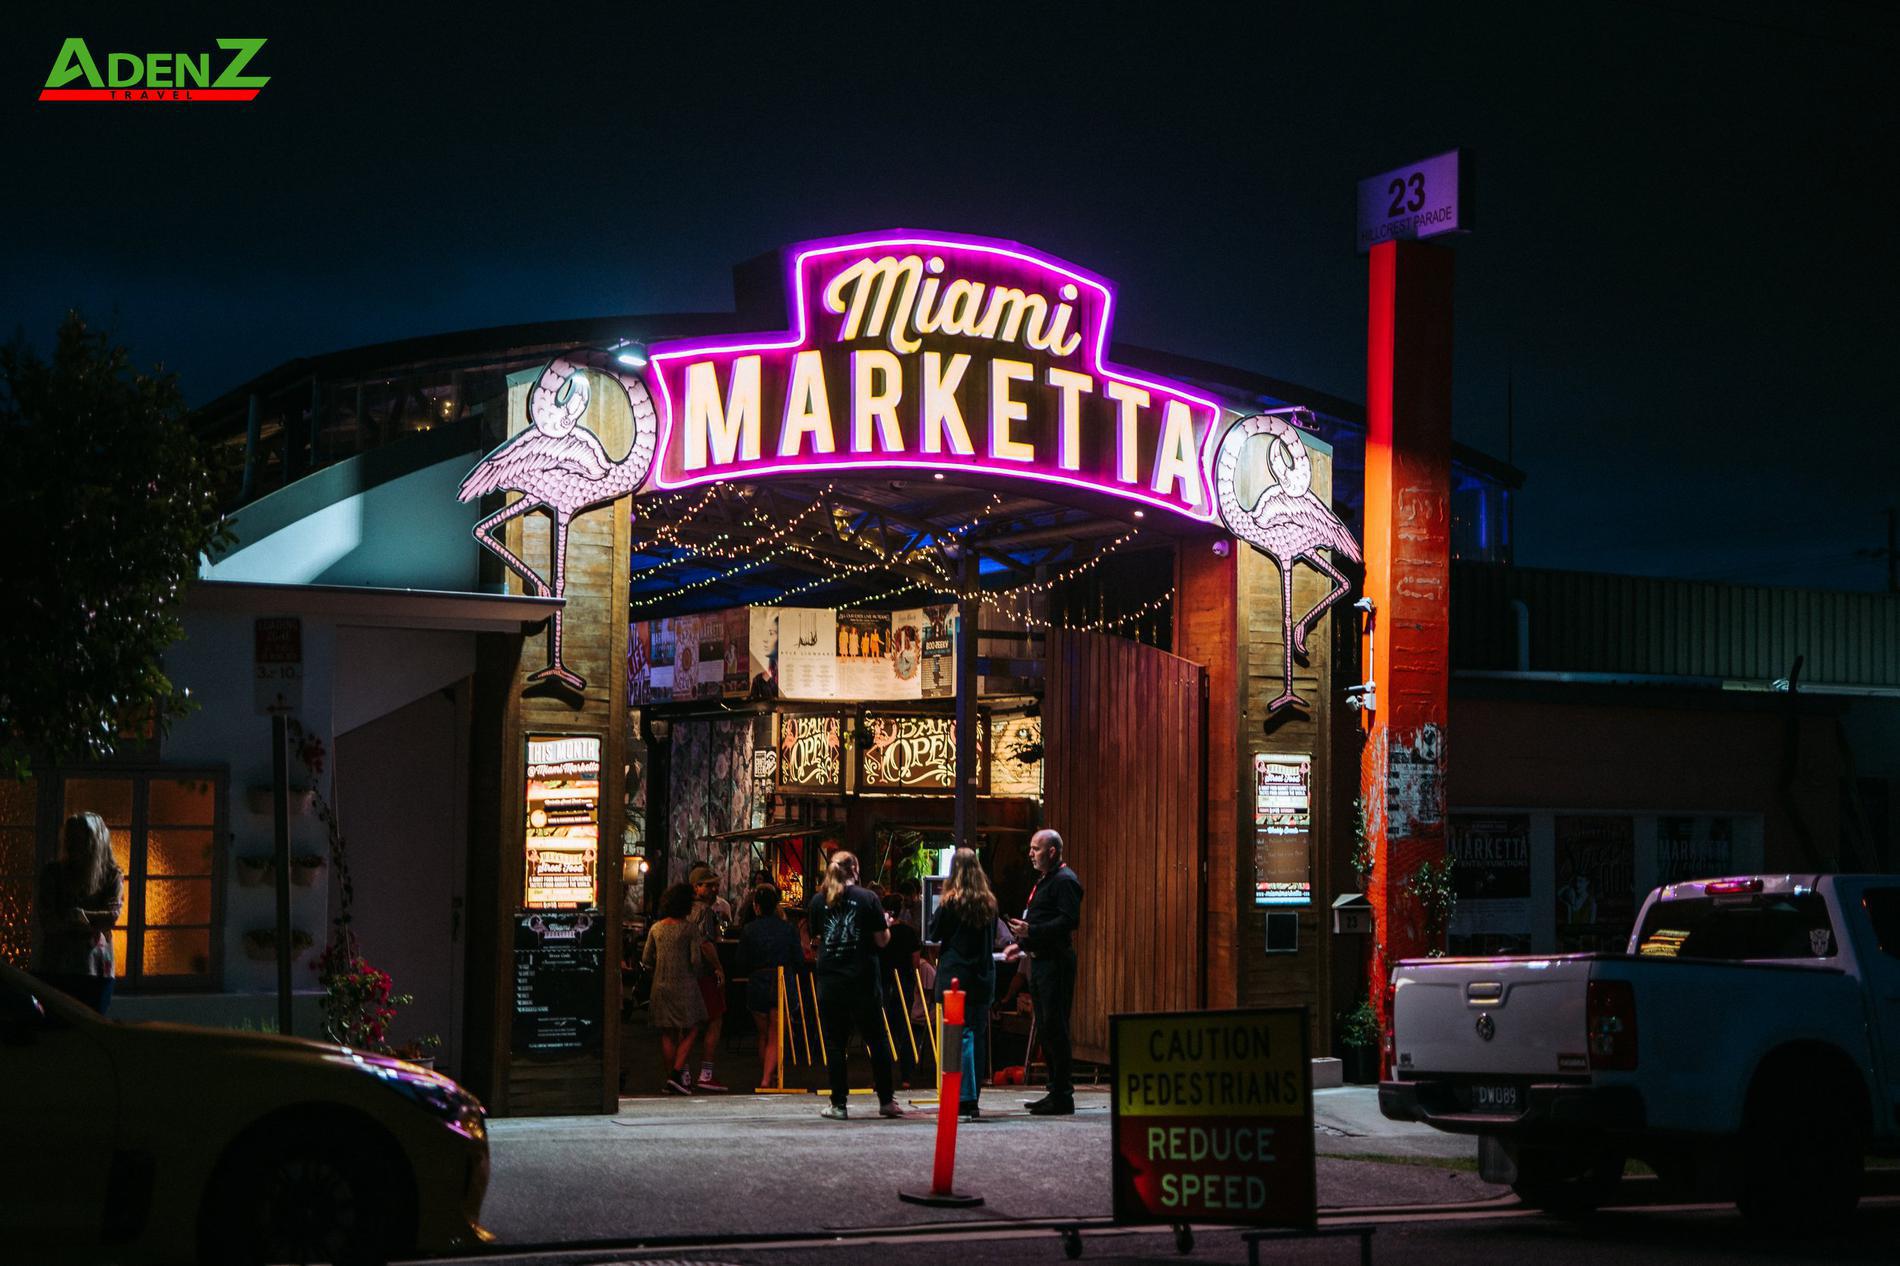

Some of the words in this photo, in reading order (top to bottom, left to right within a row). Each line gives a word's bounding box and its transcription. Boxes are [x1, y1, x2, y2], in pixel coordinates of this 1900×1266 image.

[1388, 171, 1426, 218] 23
[1361, 217, 1412, 241] HILLCREST
[1414, 206, 1453, 228] PARADE
[824, 254, 1083, 356] Miami
[683, 348, 1202, 503] MARKETTA
[798, 718, 825, 737] BAR
[896, 717, 950, 738] BAR
[529, 743, 553, 762] THIS
[556, 740, 595, 761] MONTH
[790, 732, 830, 782] OPEN
[882, 734, 957, 783] OPEN
[1150, 1024, 1271, 1062] CAUTION
[1127, 1070, 1298, 1106] PEDESTRIANS
[1148, 1126, 1277, 1162] REDUCE
[1161, 1173, 1267, 1210] SPEED
